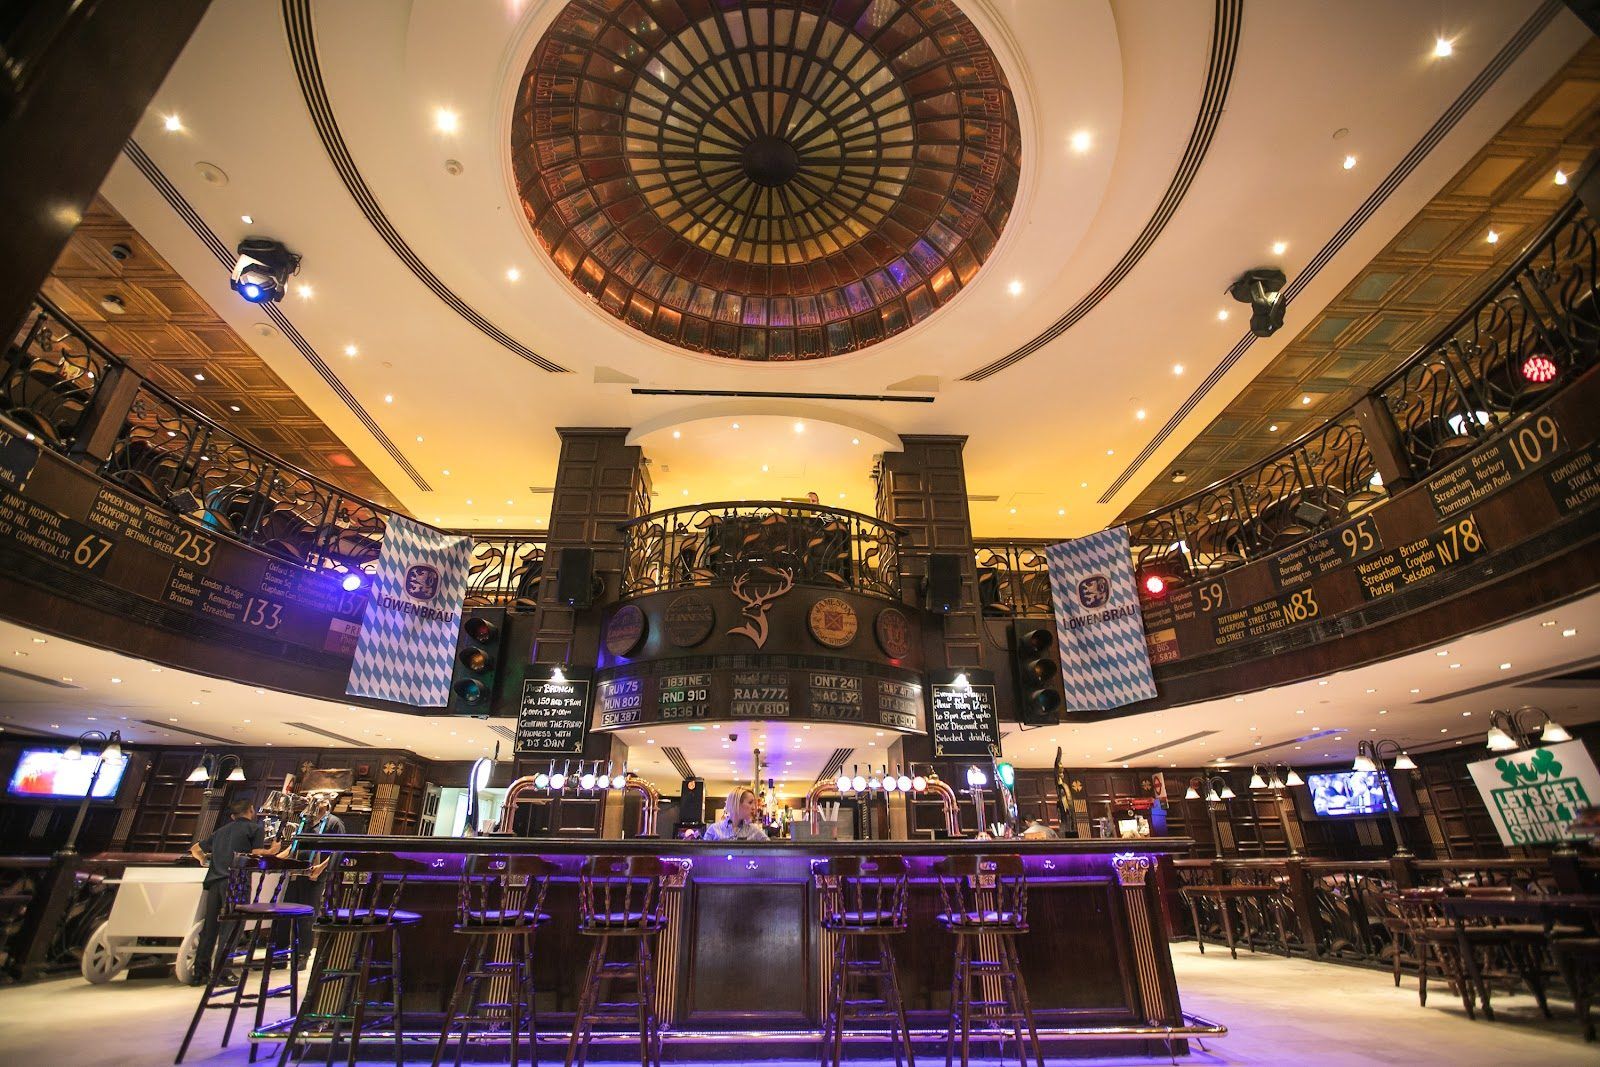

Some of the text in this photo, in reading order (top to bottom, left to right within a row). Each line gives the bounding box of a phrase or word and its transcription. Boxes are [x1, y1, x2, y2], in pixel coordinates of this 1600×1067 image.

[1508, 415, 1558, 471] 109
[1429, 446, 1500, 492] Kennington Brixton
[1434, 459, 1505, 504] Streatham Norbury
[1551, 453, 1592, 483] EDMONTON
[1568, 470, 1593, 490] STOKE
[1439, 471, 1512, 516] Thornton Heath Pond
[3, 494, 61, 528] ANN'S HOSPITAL
[96, 502, 176, 543] STAMFORD HILL CLAPTON
[99, 490, 125, 508] CAMDEN
[124, 499, 142, 515] TOWN
[144, 512, 172, 530] FINSBURY
[14, 514, 31, 528] HILL
[38, 525, 71, 546] DALSTON
[16, 530, 59, 558] COMMERCIAL
[89, 511, 175, 554] HACKNEY BETHNAL GREEN
[1308, 538, 1329, 551] Bridge
[1341, 520, 1374, 558] 95
[1436, 518, 1481, 566] N78
[74, 534, 113, 569] 67
[173, 530, 216, 566] 253
[1279, 547, 1336, 576] Borough Elephant
[1357, 538, 1430, 575] Waterloo Brixton
[1280, 556, 1343, 587] Kennington Brixton
[1361, 550, 1436, 587] Streatham Croydon
[1370, 563, 1436, 598] Purley Selsdon
[171, 578, 242, 610] Elephant Kennington
[178, 568, 244, 599] Bank London Bridge
[1200, 583, 1223, 612] 59
[169, 591, 236, 620] Brixton Streatham
[242, 597, 283, 629] 133
[377, 593, 454, 623] LÖWENBRÄU
[1063, 604, 1136, 630] LÖWENBRÄU
[1217, 600, 1278, 625] TOTTENHAM DALSTON
[1282, 588, 1319, 625] N83
[1218, 621, 1247, 635] LIVERPOOL
[1248, 614, 1268, 626] STREET
[1226, 631, 1245, 643] STREET
[1250, 625, 1267, 636] FLEET
[1266, 620, 1286, 632] STREET
[625, 682, 639, 692] 75
[662, 690, 706, 703] RND 910
[734, 688, 759, 700] RAA
[815, 676, 858, 690] ONT 241
[537, 697, 550, 705] 150
[621, 695, 640, 707] 802
[663, 706, 694, 718] 6336
[736, 703, 784, 714] WVY 810
[935, 711, 943, 720] to
[621, 711, 637, 721] 387
[936, 721, 949, 731] 50%
[950, 721, 978, 730] Discount
[543, 738, 565, 748] DAN
[936, 732, 964, 742] Selected
[1541, 781, 1581, 804] GET
[1502, 802, 1559, 826] READY
[1510, 819, 1595, 844] STUMB
